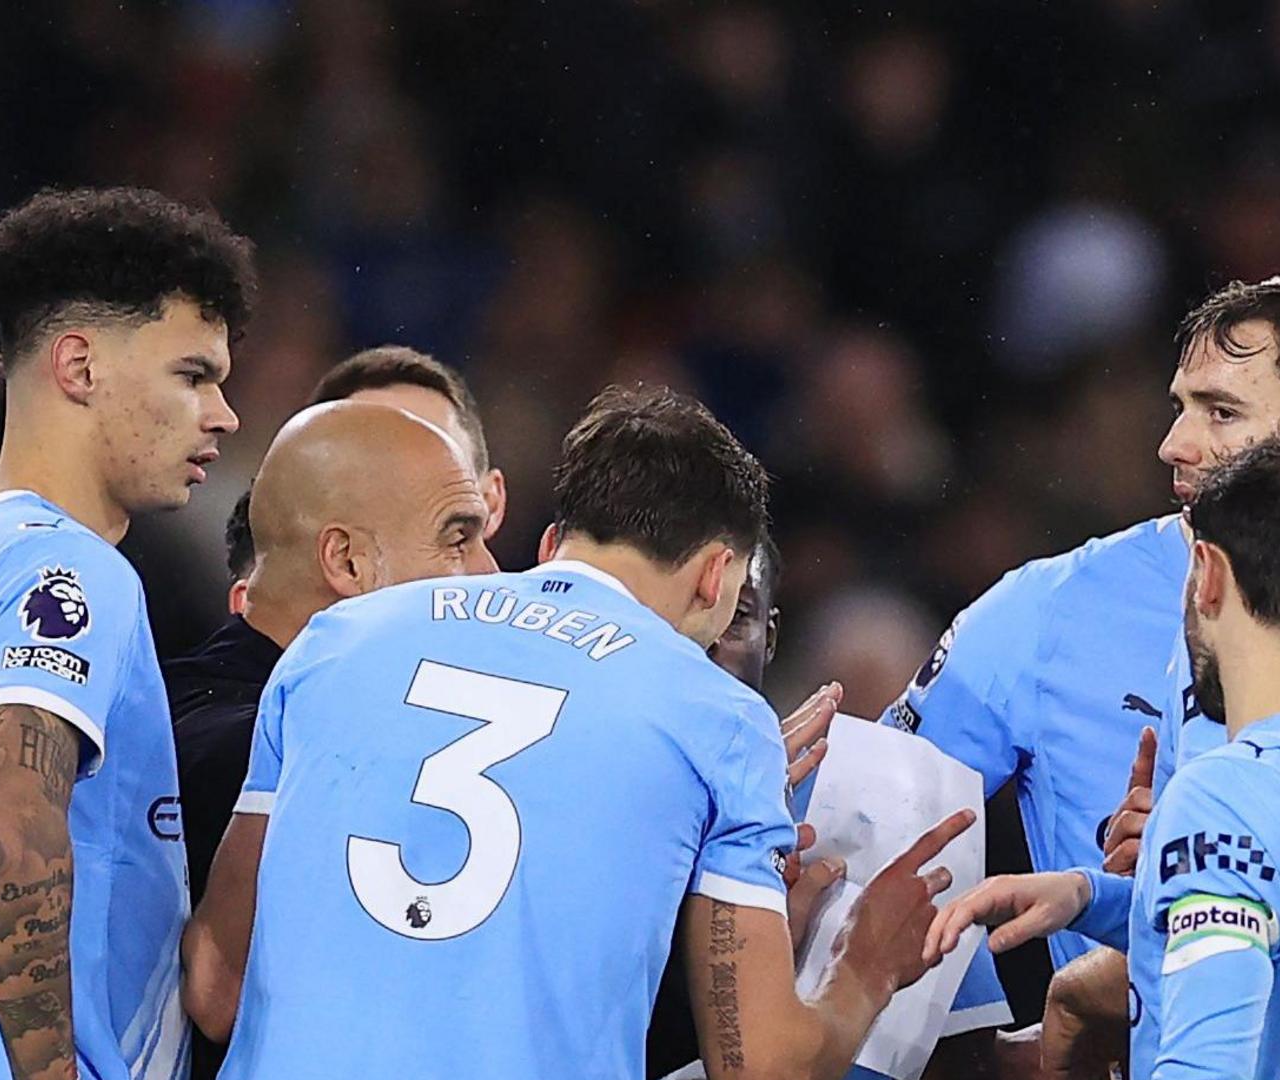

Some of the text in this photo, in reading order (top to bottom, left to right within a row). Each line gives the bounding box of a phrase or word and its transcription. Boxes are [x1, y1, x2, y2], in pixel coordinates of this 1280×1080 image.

[541, 580, 573, 594] CITY
[431, 586, 637, 662] RÚBEN
[2, 656, 87, 687] for racism
[4, 647, 82, 673] No room
[346, 658, 570, 941] 3
[1160, 831, 1276, 885] OKX
